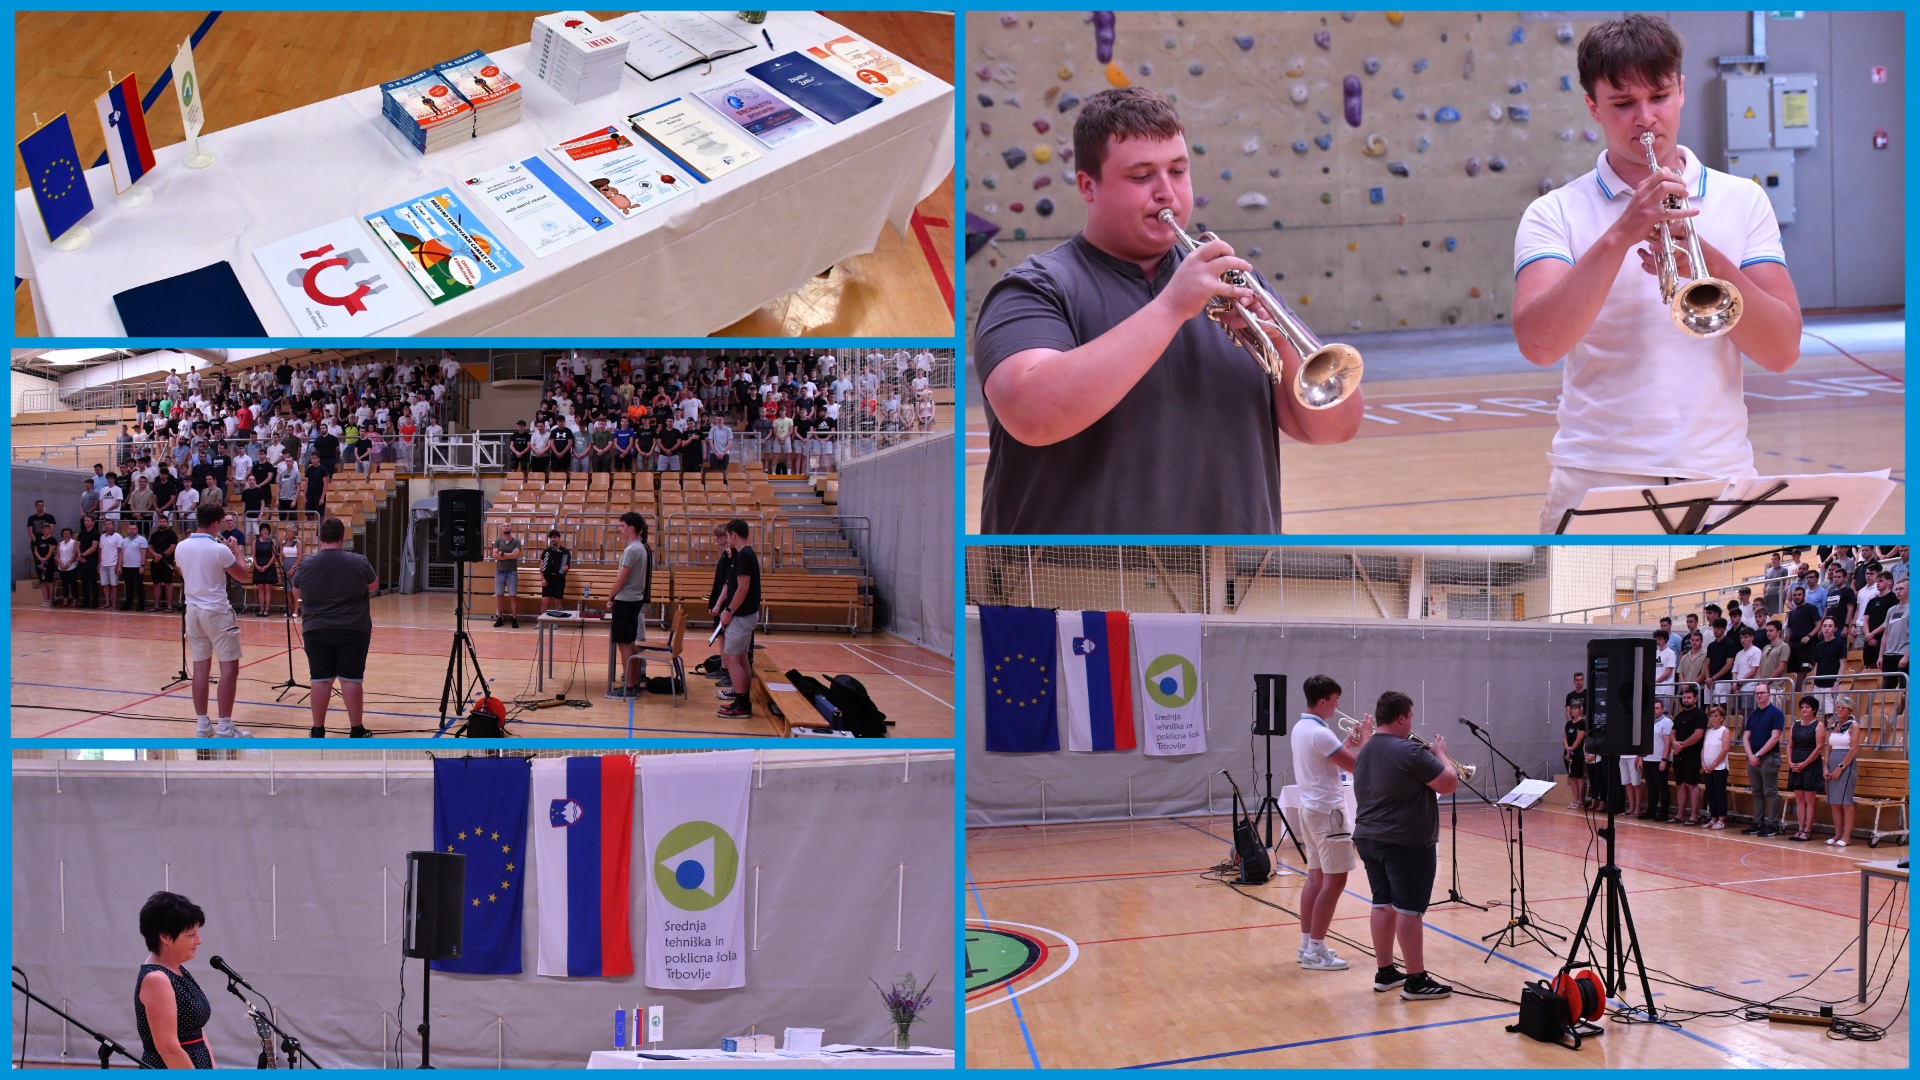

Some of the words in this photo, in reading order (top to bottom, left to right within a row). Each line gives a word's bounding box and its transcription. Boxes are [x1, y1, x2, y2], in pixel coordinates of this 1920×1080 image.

[454, 52, 478, 64] GILBERT
[402, 72, 427, 84] GILBERT
[736, 100, 772, 116] BRONASTO
[748, 106, 776, 120] priznanje
[552, 141, 584, 152] BRONASTO
[495, 184, 534, 202] POTRDILO
[430, 199, 450, 218] DRŽAVNO
[446, 216, 472, 244] TEKMOVANJE
[470, 243, 488, 260] CANSAT
[486, 258, 498, 270] 2025
[1156, 732, 1186, 741] poklicna
[665, 920, 706, 933] Srednja
[665, 936, 710, 947] tehniška
[716, 936, 724, 946] in
[665, 952, 713, 965] poklicna
[716, 950, 737, 962] šola
[666, 968, 710, 981] Trbovlje
